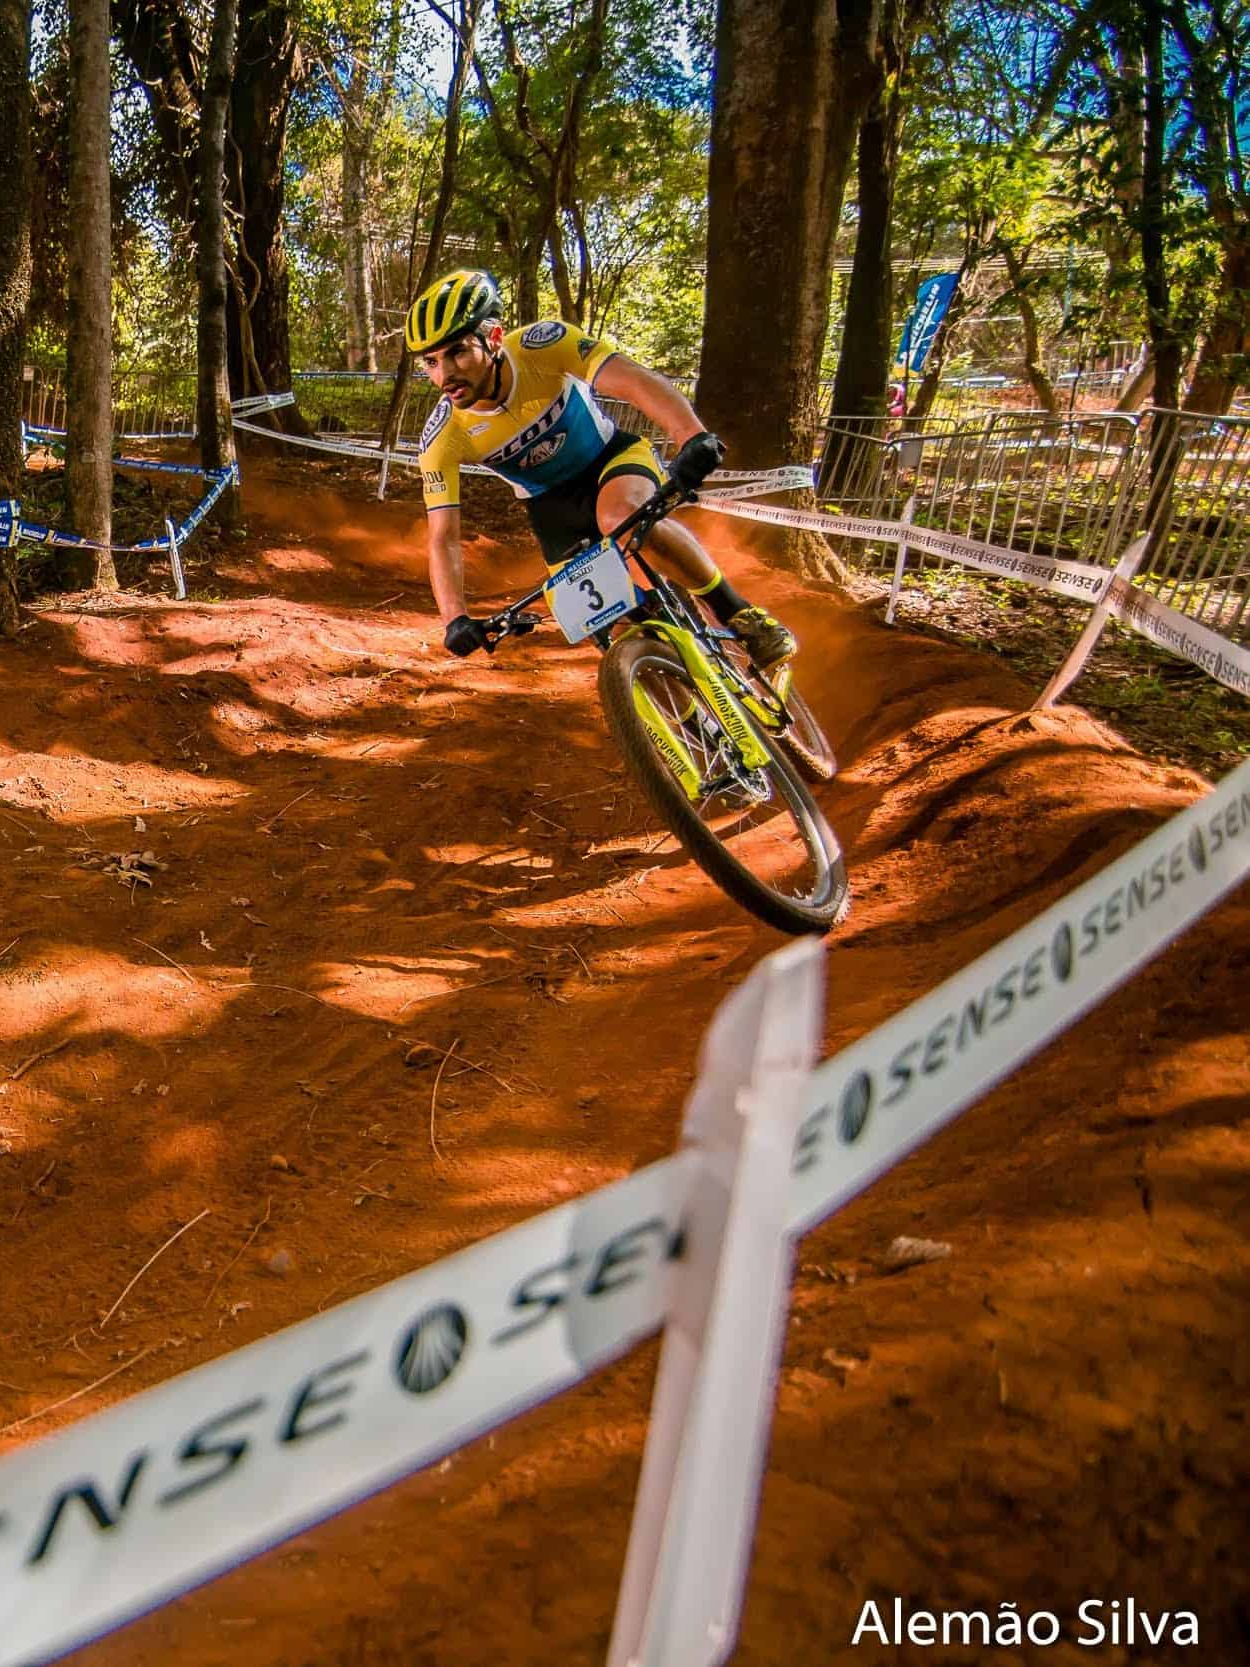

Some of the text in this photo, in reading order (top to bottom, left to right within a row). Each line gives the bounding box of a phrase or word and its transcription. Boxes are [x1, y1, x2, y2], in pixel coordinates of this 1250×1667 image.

[579, 578, 604, 611] 3
[1055, 571, 1094, 589] SENSE
[879, 945, 1047, 1107] SENSE
[1080, 842, 1186, 957] SENSE
